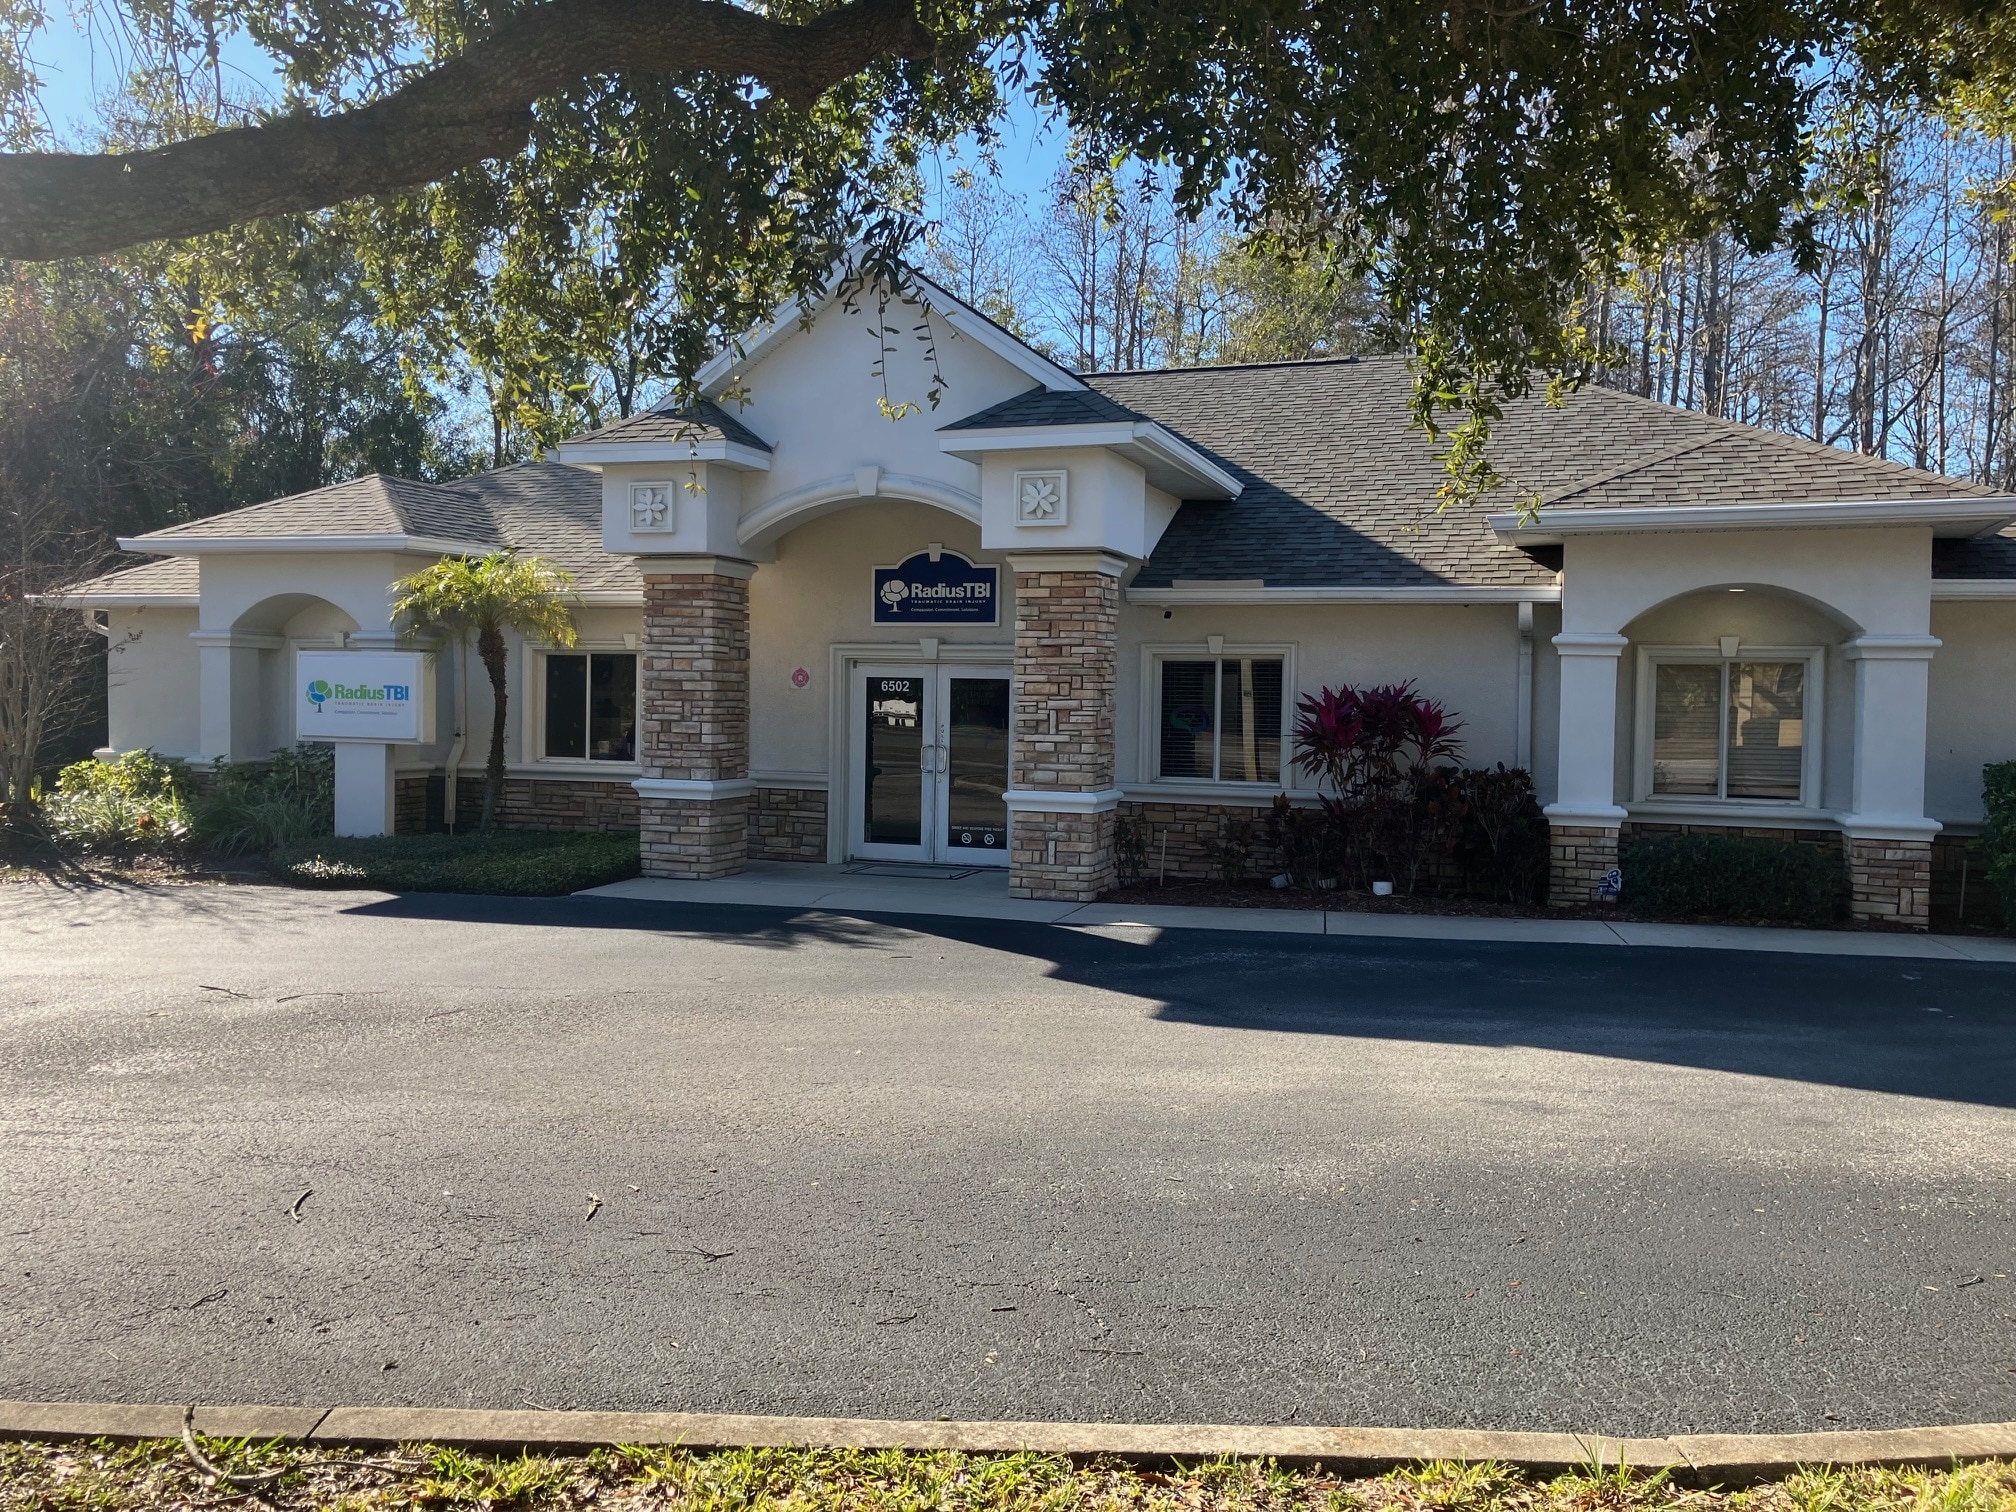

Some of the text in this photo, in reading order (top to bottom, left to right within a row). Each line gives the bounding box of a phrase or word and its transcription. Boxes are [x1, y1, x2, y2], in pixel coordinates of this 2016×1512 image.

[911, 582, 990, 598] RadiusTBI
[334, 684, 409, 701] RadiusTBI
[881, 680, 909, 691] 6502
